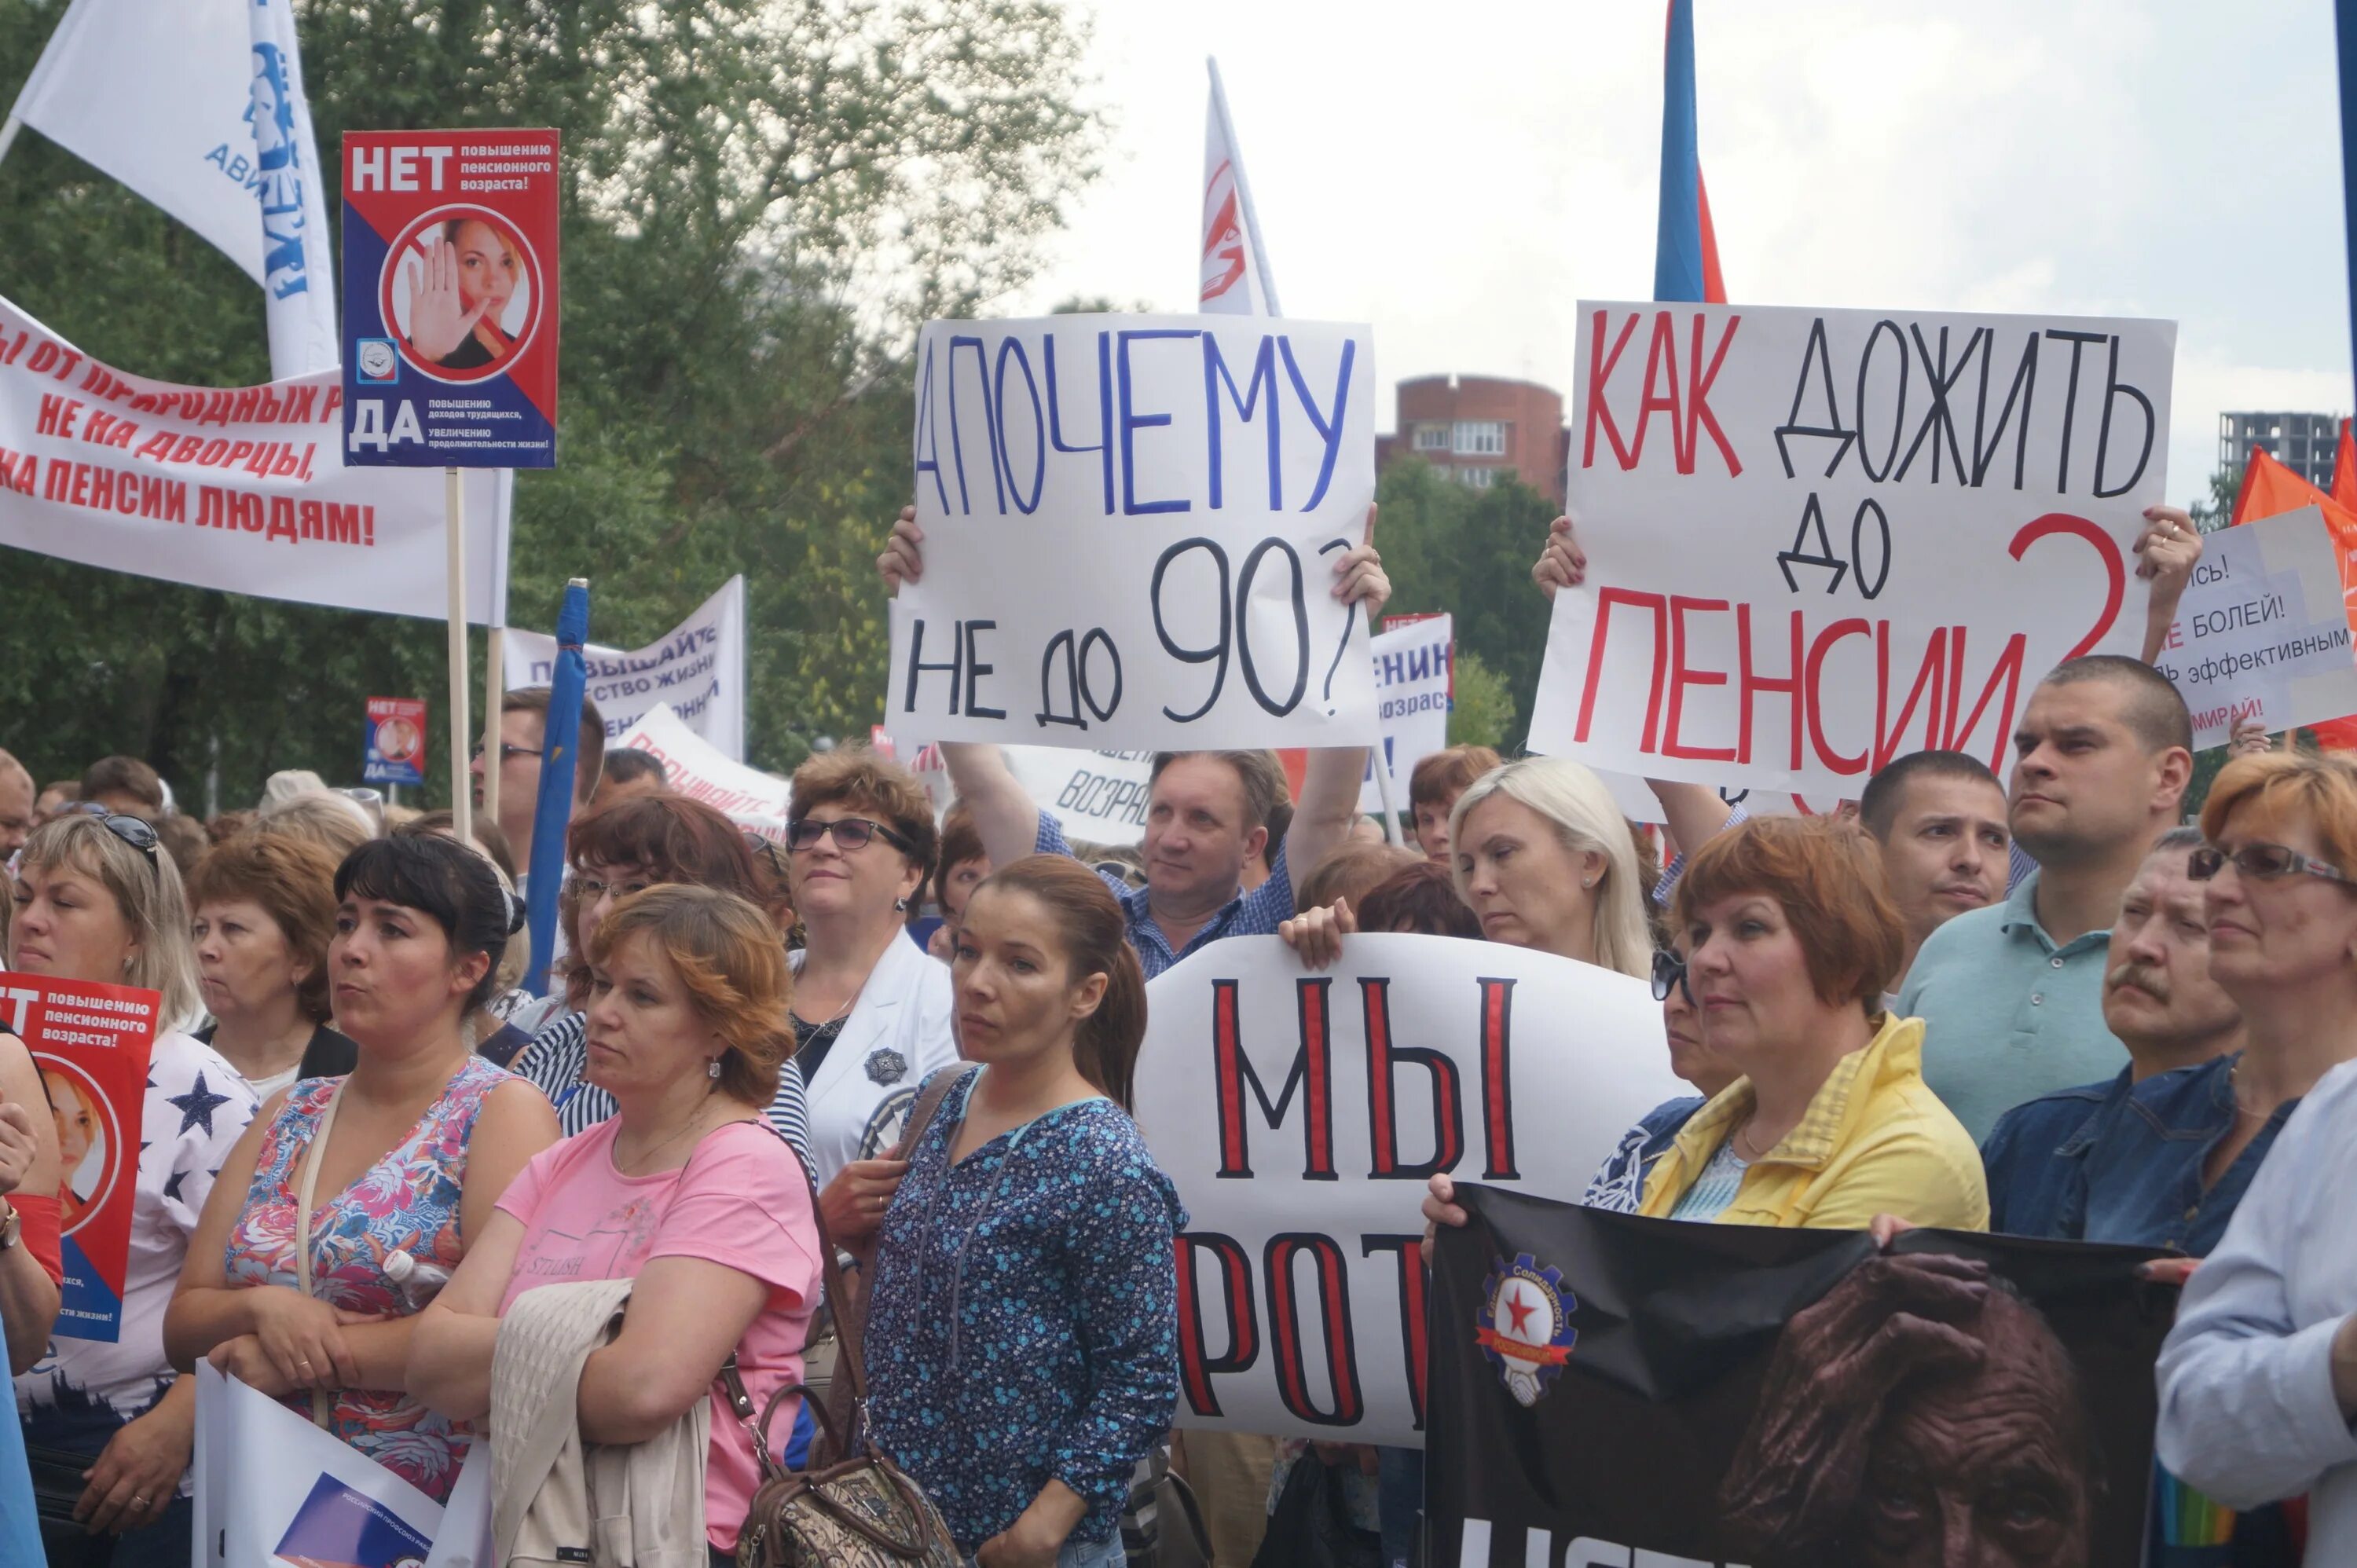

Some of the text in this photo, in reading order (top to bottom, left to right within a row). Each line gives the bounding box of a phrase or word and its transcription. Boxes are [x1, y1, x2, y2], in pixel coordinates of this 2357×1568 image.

[352, 146, 453, 192] НЕТ
[460, 144, 551, 156] повышению
[460, 161, 551, 174] пенсионного
[460, 177, 529, 192] возраста!
[26, 339, 82, 381] ОТ
[428, 399, 492, 408] ПОВЫШЕНИЮ
[467, 411, 522, 419] трудящихся,
[1582, 310, 2155, 498] КАК ДОЖИТЬ
[36, 393, 317, 483] НЕ НА ДВОРЦЫ,
[349, 399, 424, 452] ДА
[428, 429, 492, 438] УВЕЛИЧЕНИЮ
[428, 440, 549, 449] продолжительности жизни!
[44, 457, 187, 524] ПЕНСИИ
[195, 484, 375, 546] ЛЮДЯМ!
[1776, 492, 1891, 600] ДО
[904, 536, 1357, 731] НЕ ДО 90?
[2192, 592, 2286, 639] БОЛЕЙ!
[530, 621, 717, 682] ПВЫШАЙТЕ
[2187, 628, 2350, 685] эффективным
[2192, 696, 2264, 732] МИРАЙ!
[45, 1009, 147, 1033] пенсионного
[47, 992, 150, 1016] повышению
[42, 1028, 118, 1047] возраста!
[1211, 976, 1521, 1181] МЫ
[76, 1310, 113, 1322] жизни!
[1513, 1266, 1563, 1337] Солидарность
